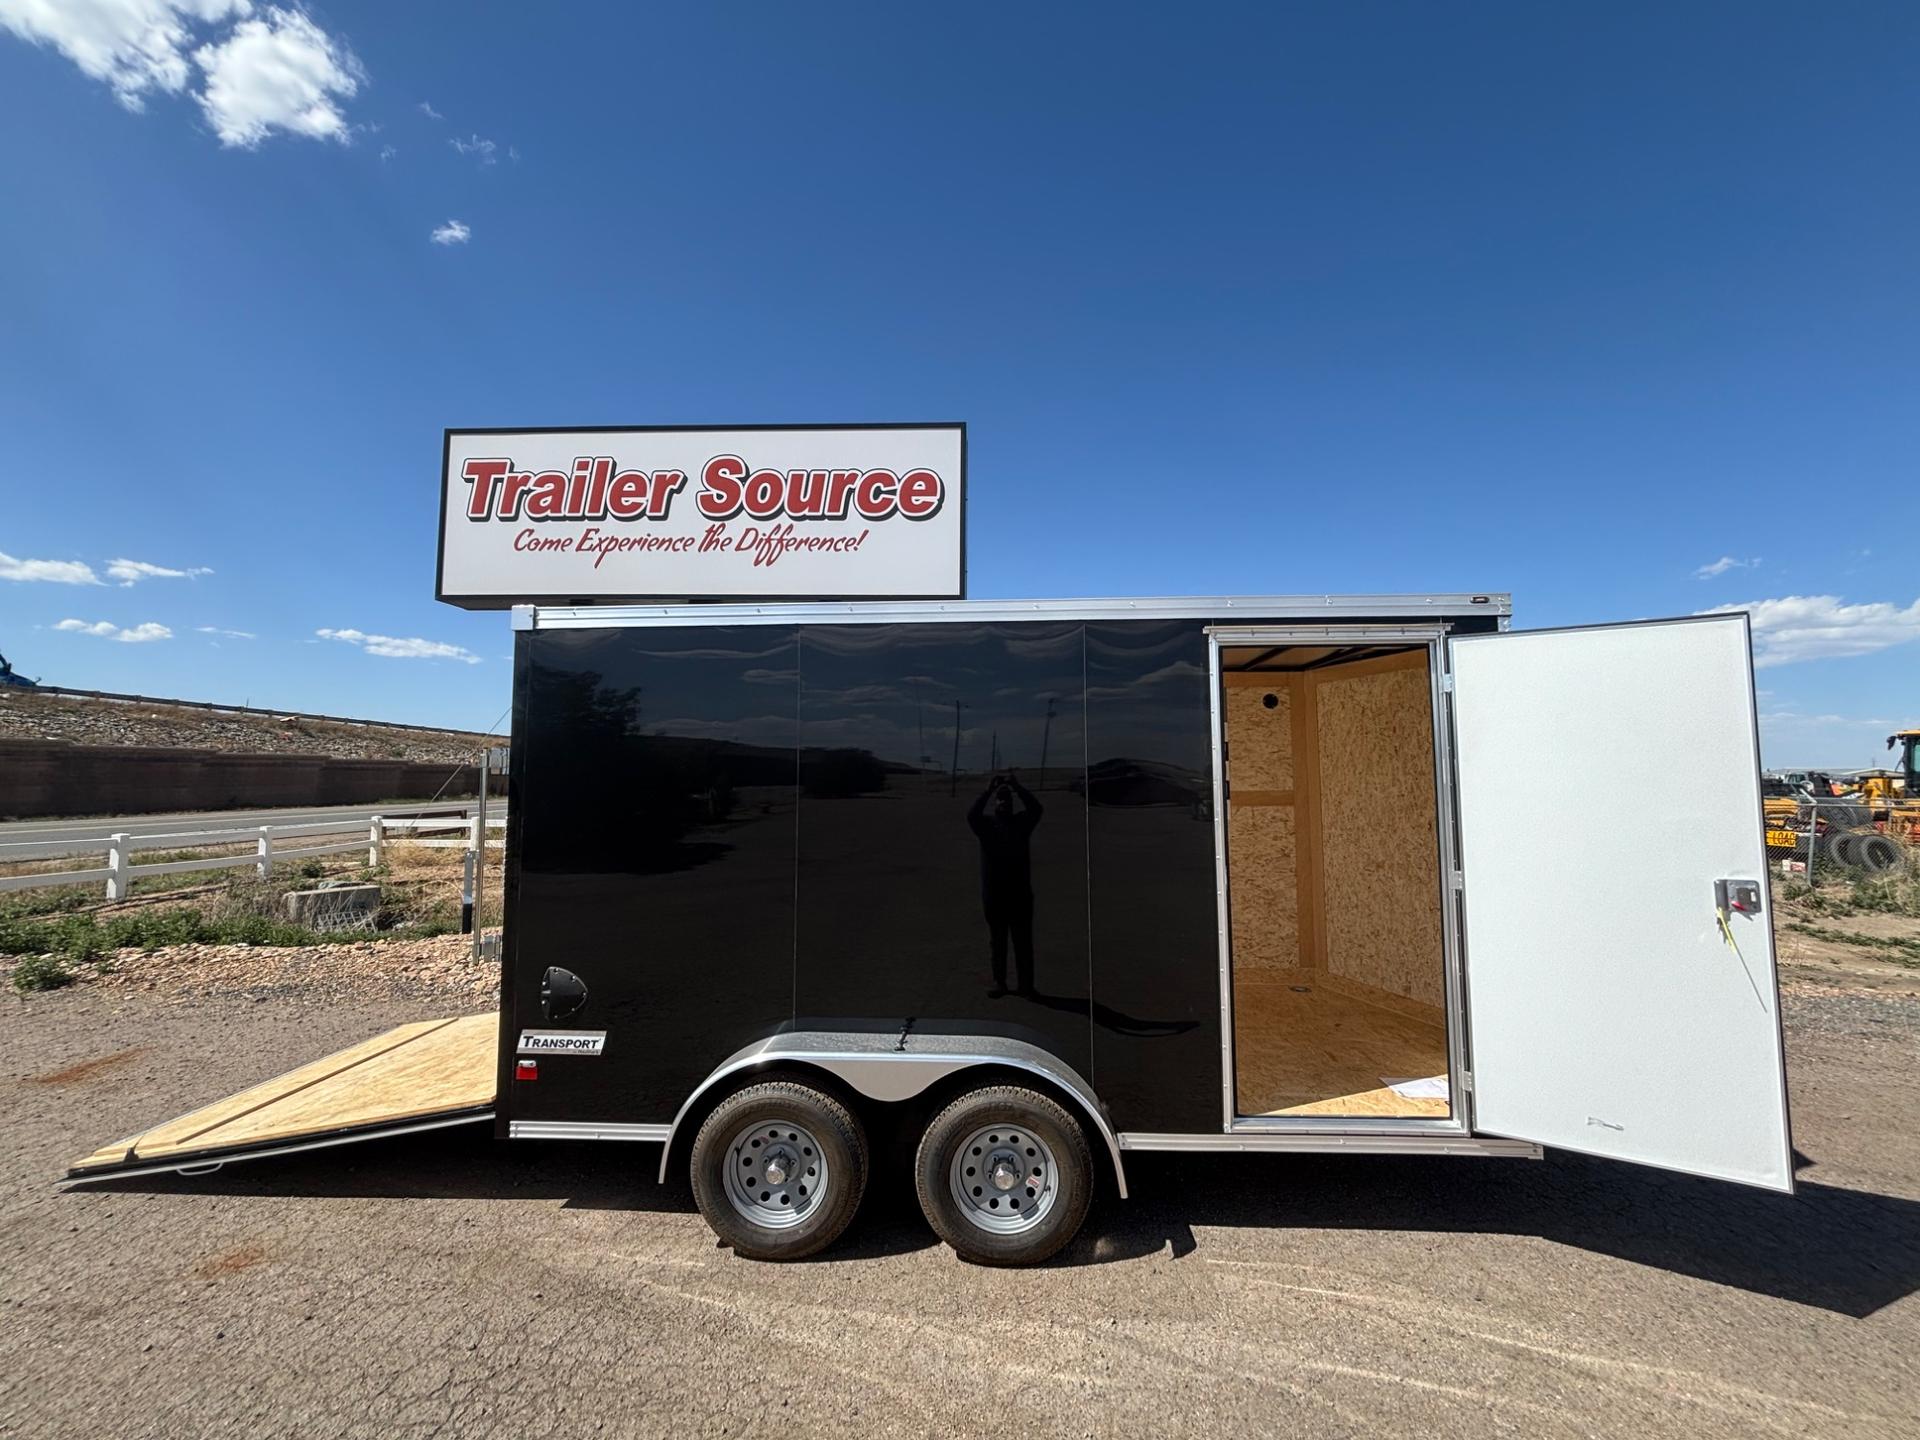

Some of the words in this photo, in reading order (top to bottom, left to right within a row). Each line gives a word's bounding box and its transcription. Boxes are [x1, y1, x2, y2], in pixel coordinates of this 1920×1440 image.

[462, 457, 688, 522] Trailer
[696, 454, 945, 521] Source
[514, 528, 573, 552] Come
[575, 528, 695, 569] Experience
[698, 522, 733, 552] the
[735, 523, 869, 567] Difference!
[522, 1036, 599, 1049] TRANSPORT
